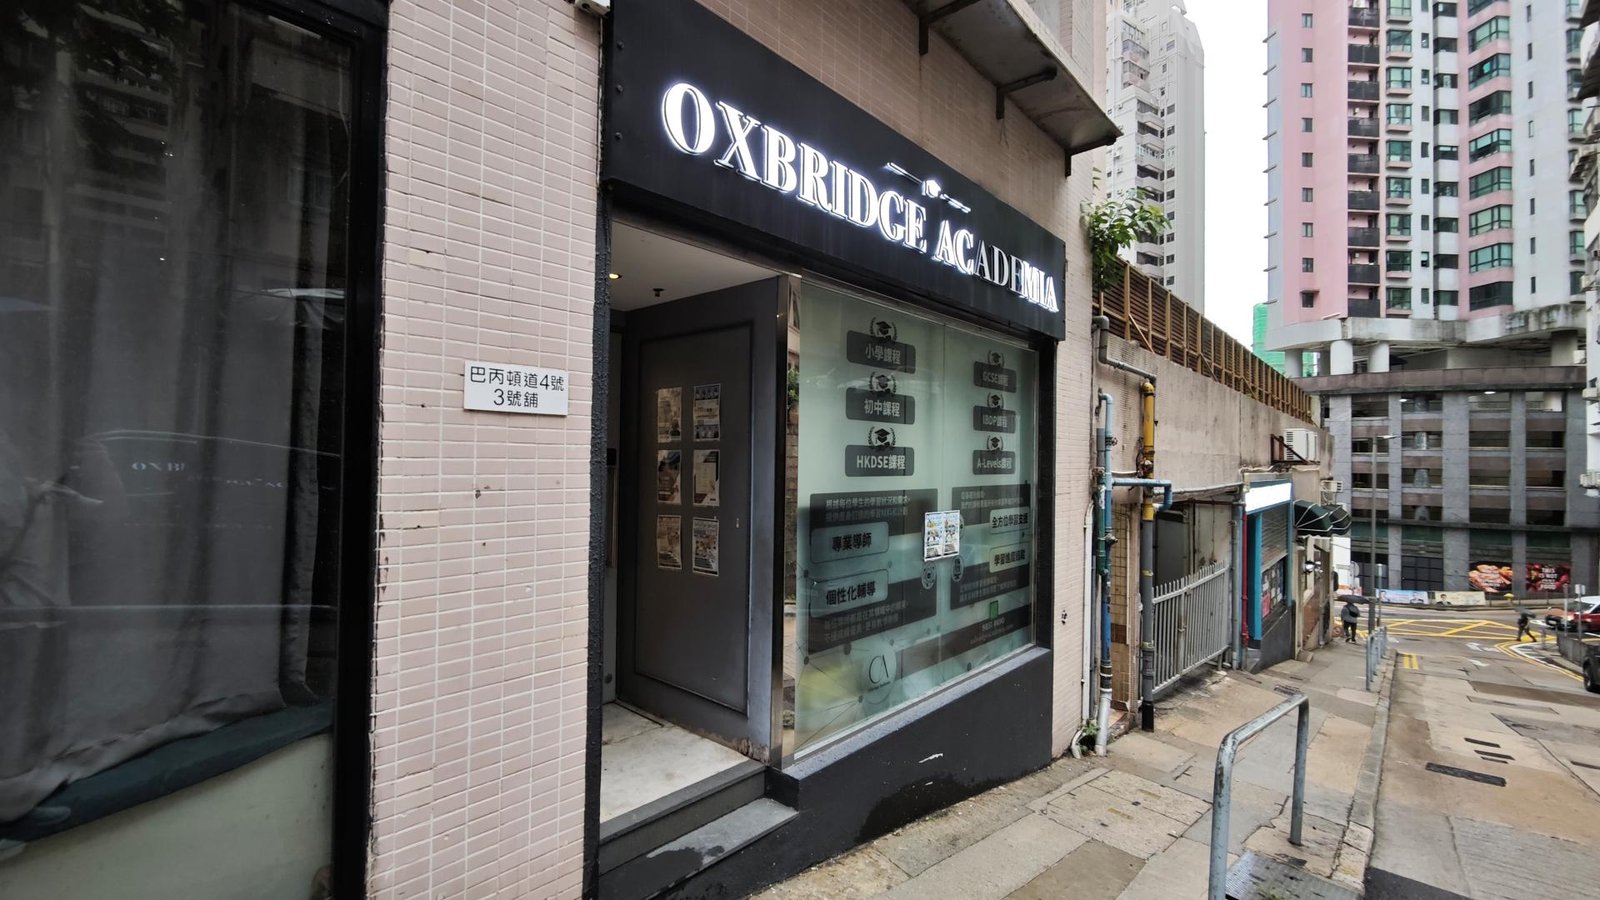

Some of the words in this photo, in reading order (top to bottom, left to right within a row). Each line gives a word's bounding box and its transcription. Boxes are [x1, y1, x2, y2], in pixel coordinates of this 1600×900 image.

[661, 82, 927, 253] OXBRIDGE
[932, 220, 1060, 313] ACADEMIA
[865, 344, 901, 364] 小學課程
[470, 366, 565, 391] 巴丙頓道4號
[864, 399, 900, 417] 初中課程
[856, 455, 906, 470] HKDSE課程
[977, 457, 1012, 469] A-Levels課程
[832, 533, 872, 552] 專業導師
[826, 581, 876, 605] 個性化輔導
